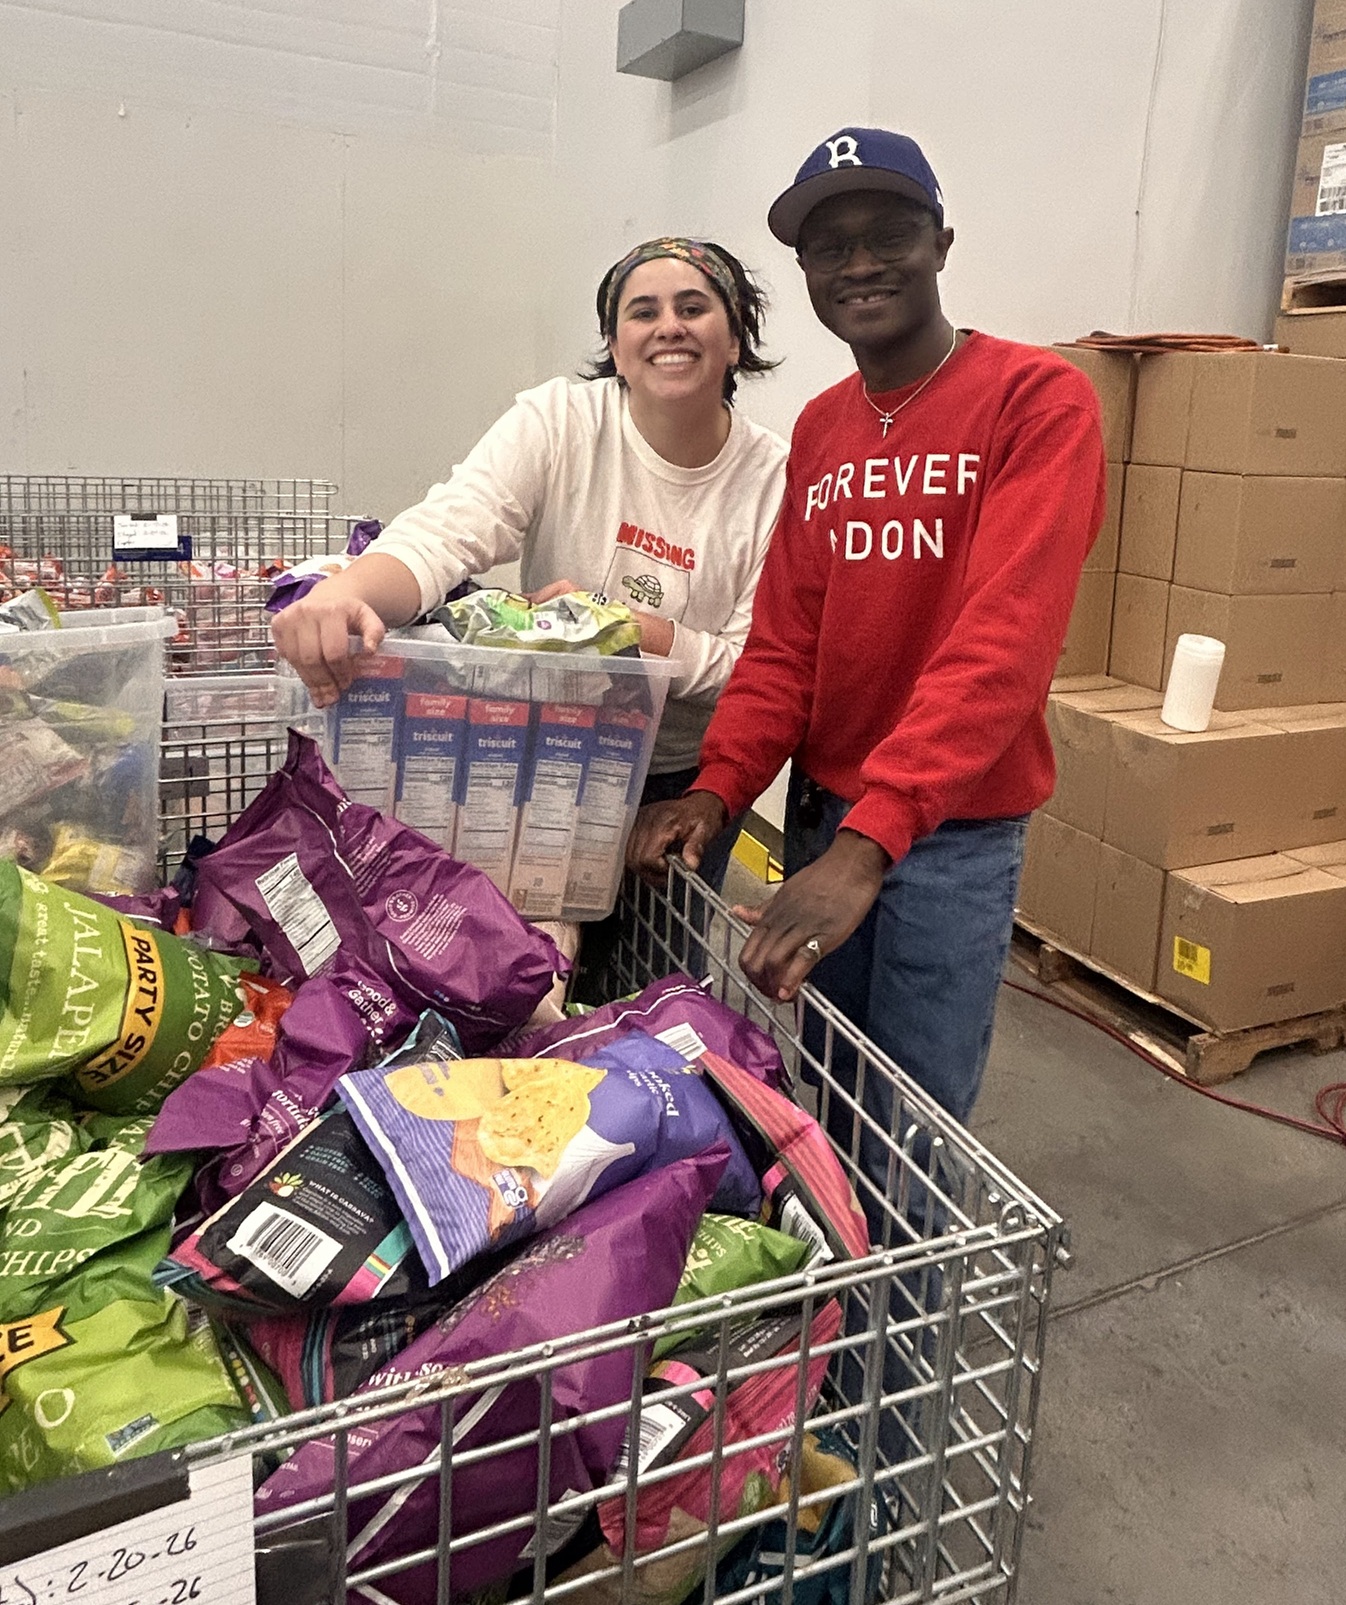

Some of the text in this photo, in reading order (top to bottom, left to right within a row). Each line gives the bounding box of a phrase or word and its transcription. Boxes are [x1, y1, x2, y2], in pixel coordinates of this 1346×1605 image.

[616, 522, 695, 571] MISSING
[830, 518, 943, 560] DON
[348, 692, 391, 702] triscuit
[420, 698, 452, 708] family
[426, 708, 445, 716] size
[485, 705, 514, 716] family
[413, 731, 453, 742] triscuit
[478, 737, 517, 749] triscuit
[545, 737, 582, 750] triscuit
[599, 735, 633, 750] triscuit
[35, 902, 49, 945] great
[181, 946, 211, 1042] POTATO
[82, 936, 158, 1084] PARTY SIZE
[347, 988, 384, 1025] Gather
[207, 999, 234, 1049] BRA
[309, 1179, 331, 1196] WHAT
[698, 1229, 727, 1257] HIPS
[67, 1527, 198, 1592] 2-20-26
